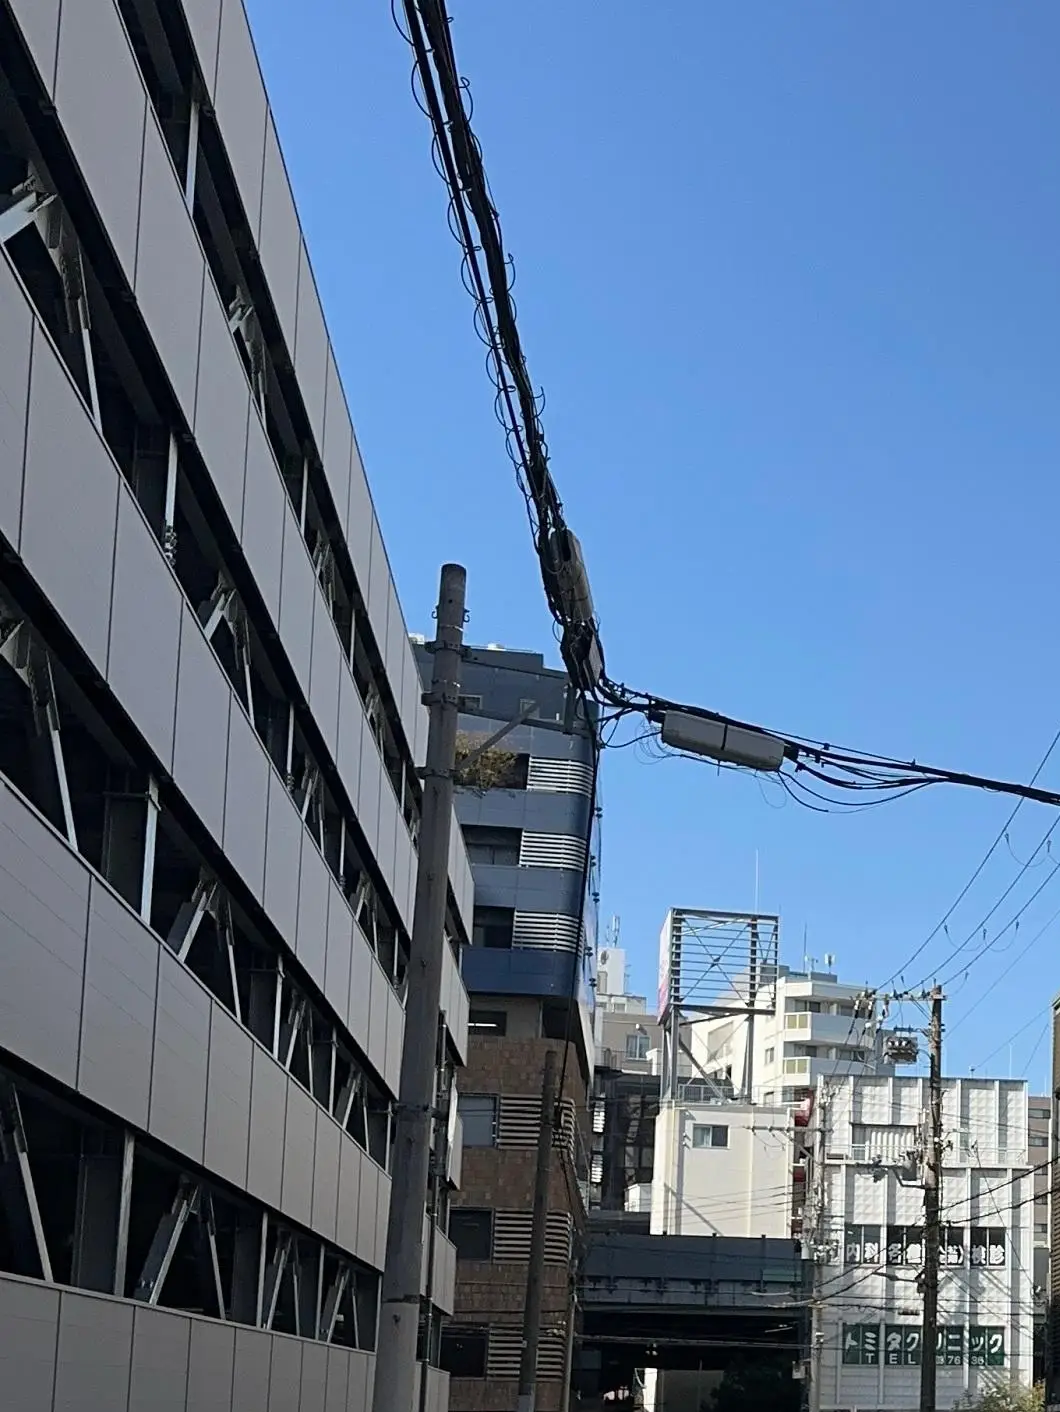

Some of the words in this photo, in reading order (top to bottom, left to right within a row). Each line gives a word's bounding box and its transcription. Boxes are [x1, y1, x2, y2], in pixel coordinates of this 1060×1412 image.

[844, 1331, 1003, 1354] トミタクリニック
[865, 1353, 916, 1365] TEL
